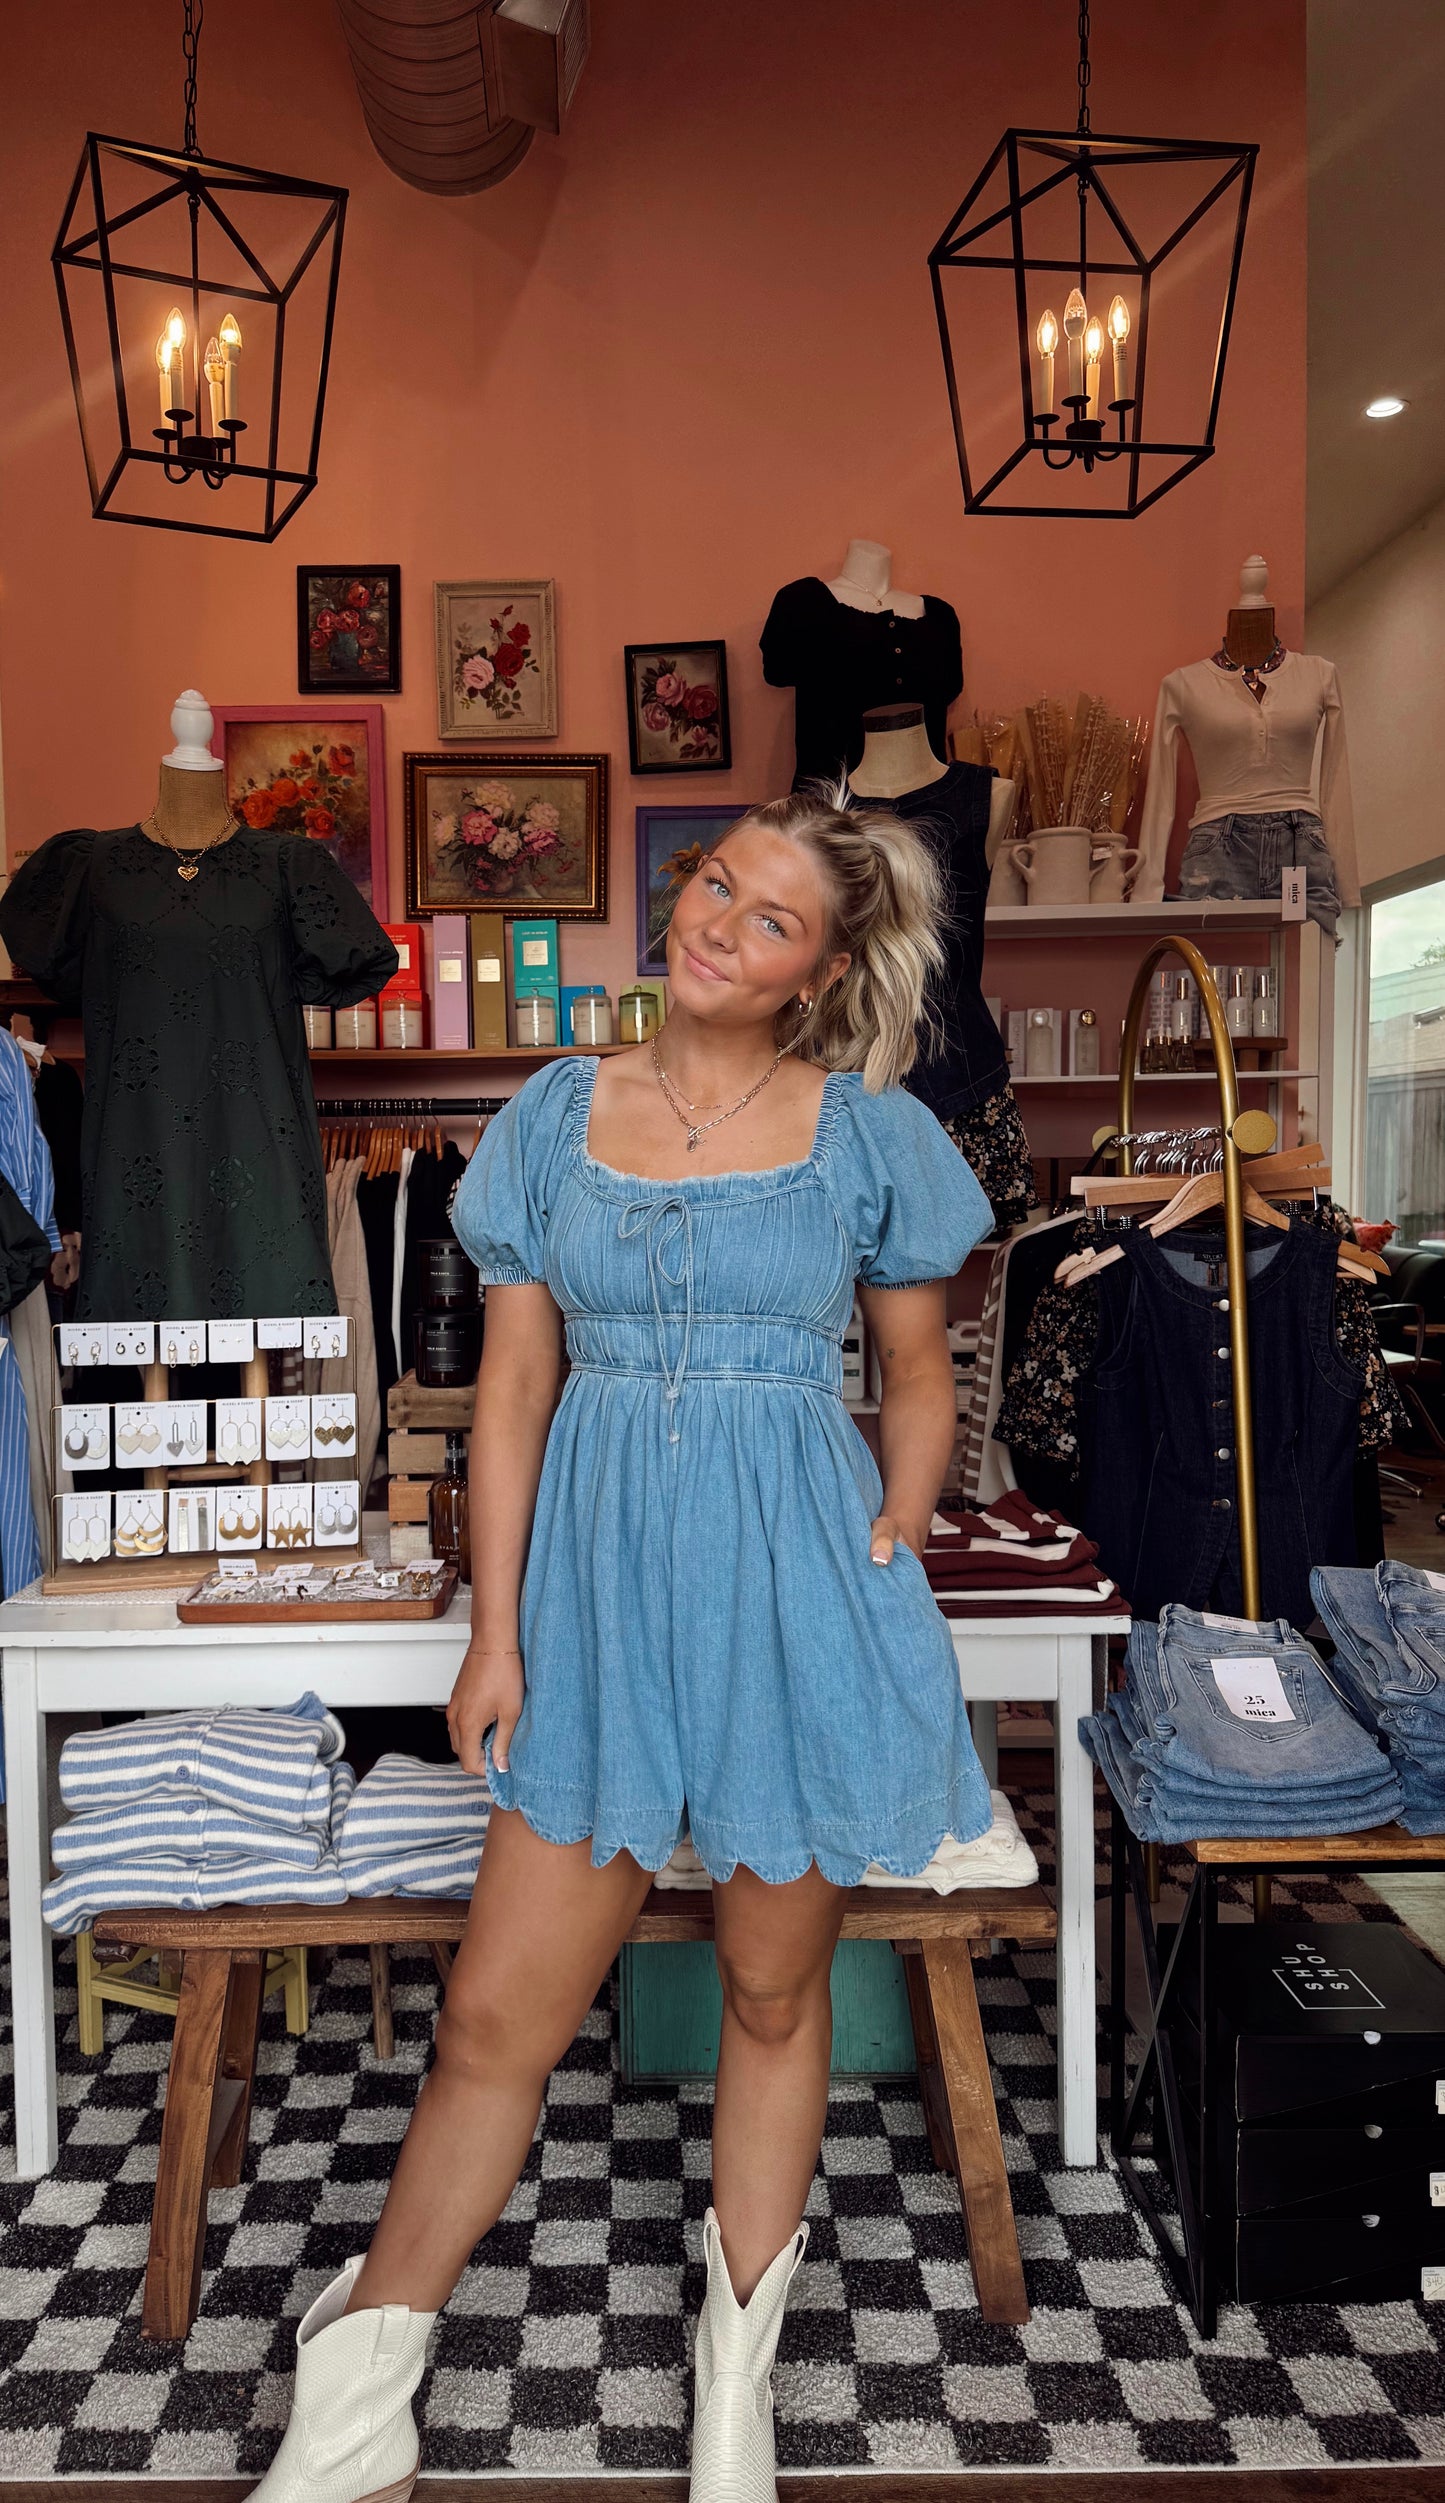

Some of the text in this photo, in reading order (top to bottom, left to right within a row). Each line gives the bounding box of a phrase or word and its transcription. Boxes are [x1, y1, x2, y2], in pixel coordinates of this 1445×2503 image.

[1292, 883, 1300, 903] mica
[1244, 1695, 1265, 1705] 25
[1245, 1708, 1276, 1717] mica
